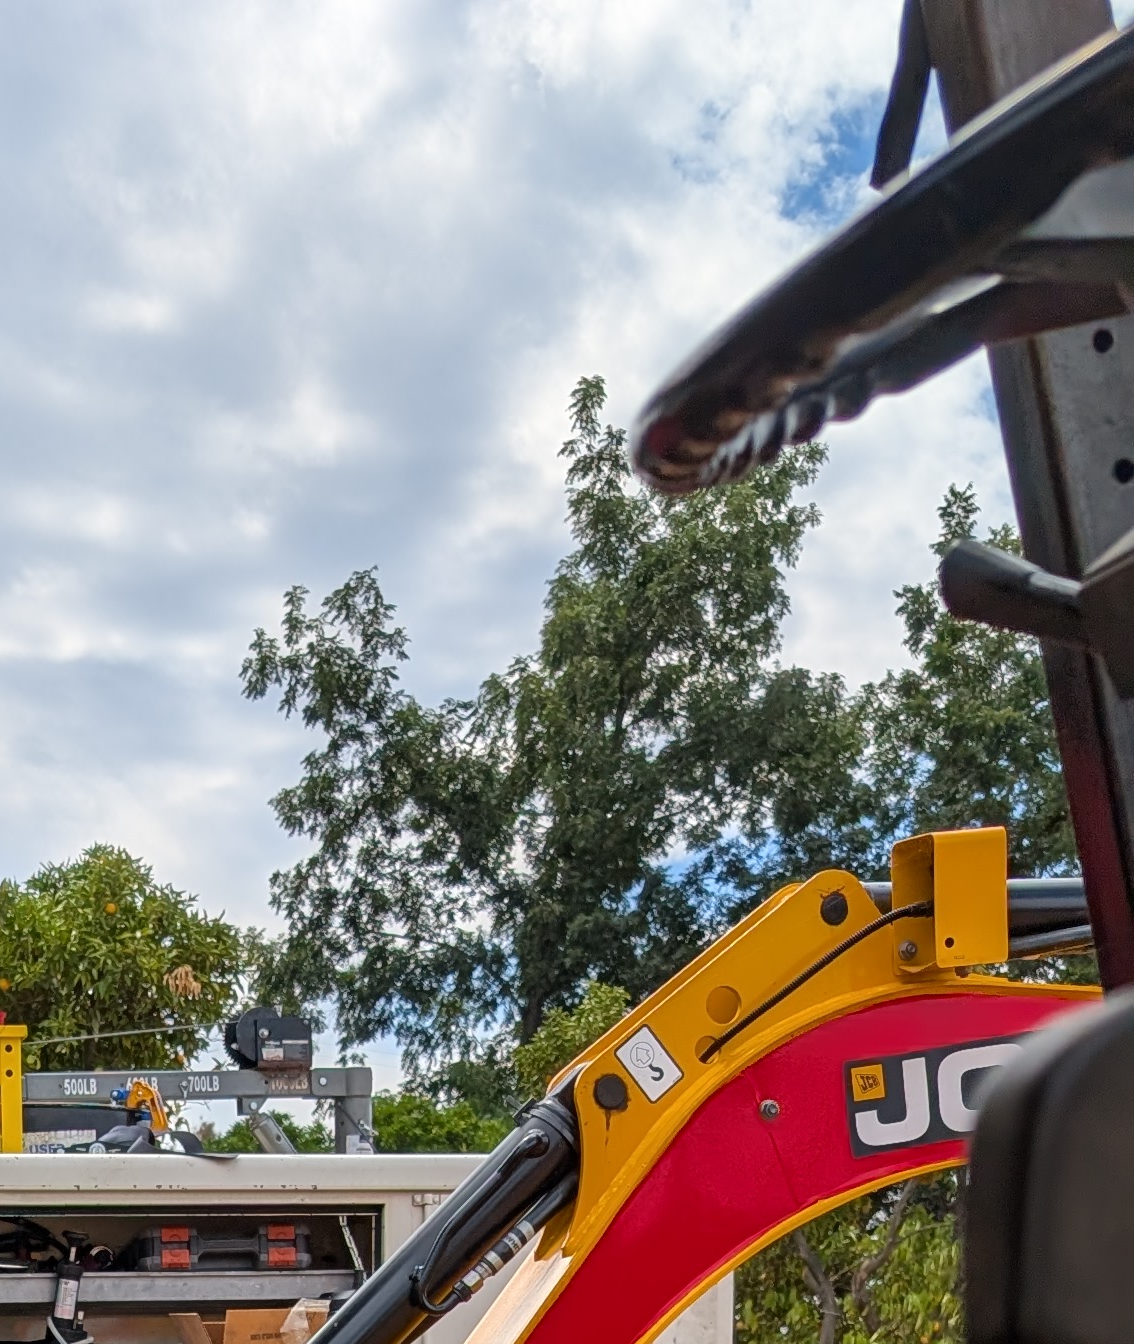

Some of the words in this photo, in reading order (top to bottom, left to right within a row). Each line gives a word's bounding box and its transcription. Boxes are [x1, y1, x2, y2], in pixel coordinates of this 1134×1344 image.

[63, 1078, 97, 1096] 500LB
[126, 1076, 158, 1092] 6LB
[187, 1075, 220, 1092] 700LB
[859, 1075, 880, 1092] JCB
[855, 1044, 1024, 1147] JC
